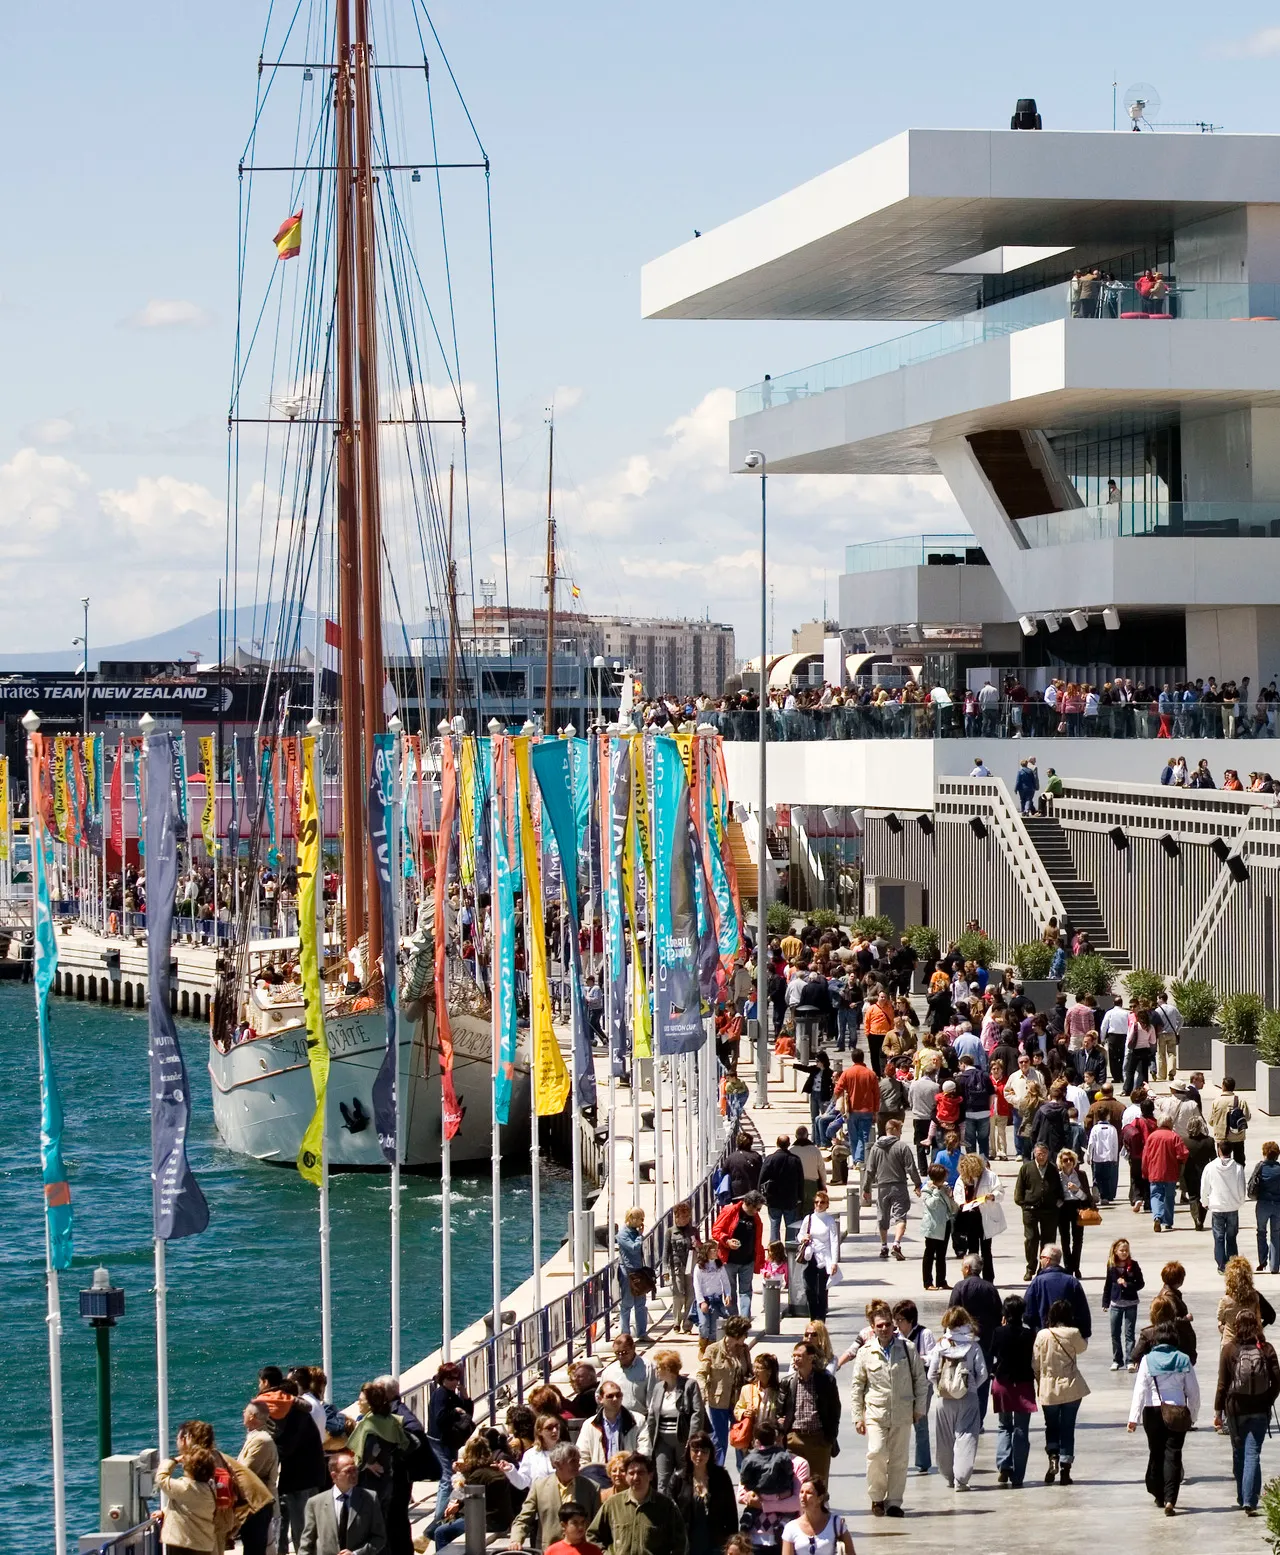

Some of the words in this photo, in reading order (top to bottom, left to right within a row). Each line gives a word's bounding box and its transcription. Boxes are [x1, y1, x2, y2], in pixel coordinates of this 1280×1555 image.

[43, 686, 90, 699] TEAM
[92, 686, 132, 699] NEW
[132, 686, 208, 699] ZEALAND
[657, 751, 665, 797] CUP
